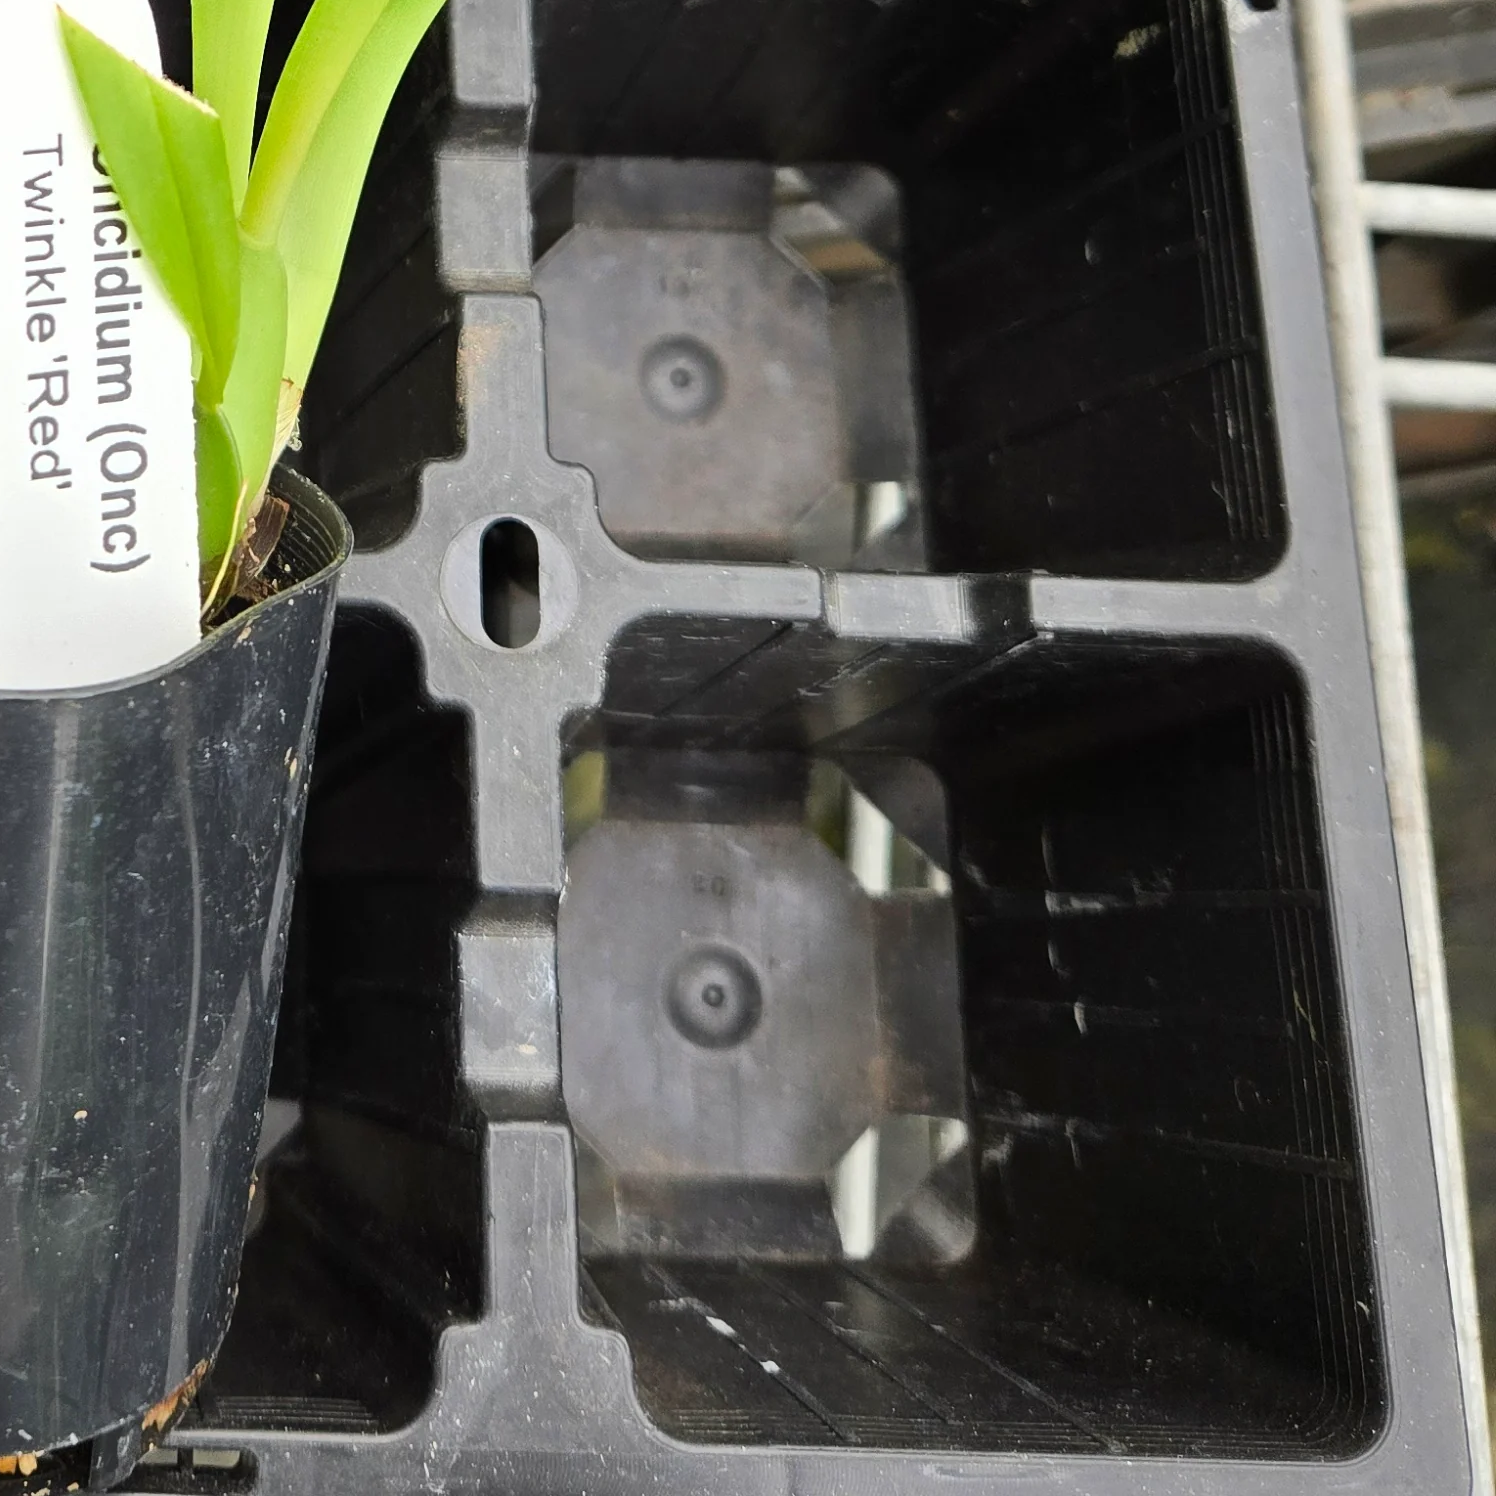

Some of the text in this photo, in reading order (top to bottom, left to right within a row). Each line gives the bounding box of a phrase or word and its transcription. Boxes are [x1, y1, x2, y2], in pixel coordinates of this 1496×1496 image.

[22, 133, 72, 490] Twinkle 'Red'
[86, 423, 151, 573] (Onc)
